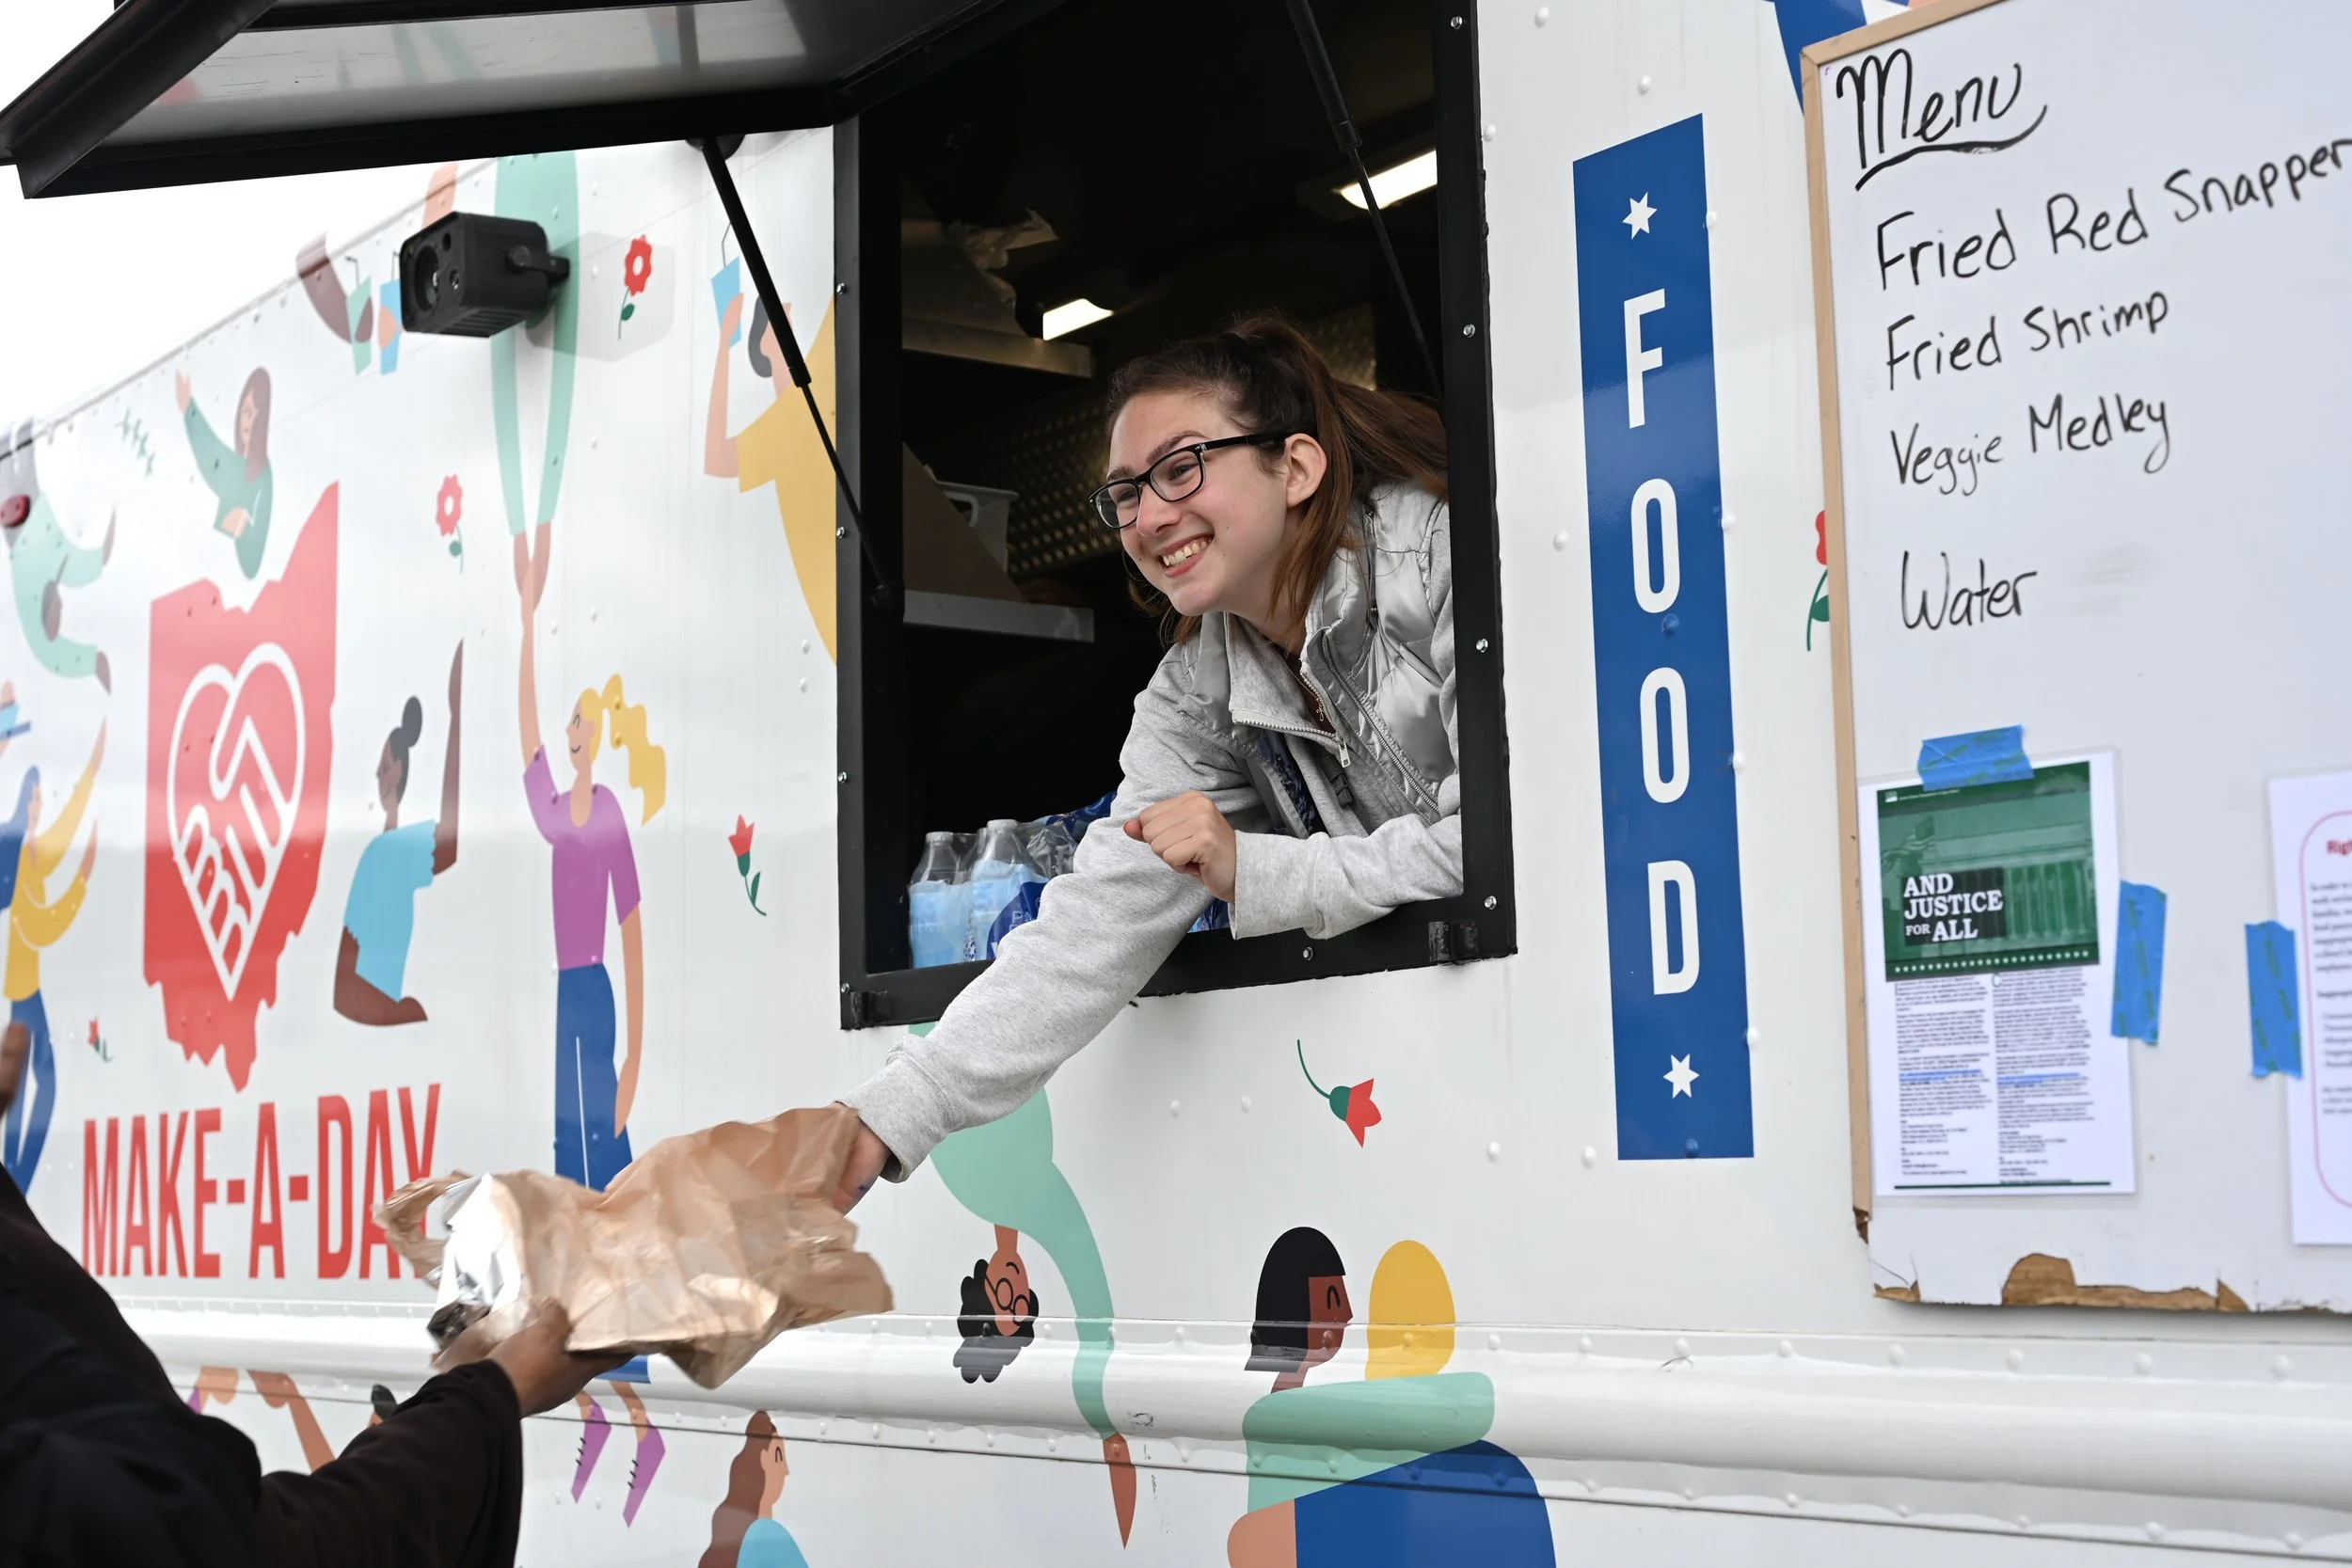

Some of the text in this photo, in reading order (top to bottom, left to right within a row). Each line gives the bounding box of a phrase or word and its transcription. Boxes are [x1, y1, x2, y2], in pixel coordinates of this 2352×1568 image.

[1836, 48, 2022, 170] Menu
[1877, 138, 2352, 291] Fried Red Snapper
[1886, 291, 2169, 391] Fried Shrimp
[1890, 393, 2170, 498] Veggie Medley
[1900, 550, 2038, 631] Water
[1624, 288, 1700, 996] FOOD
[1903, 873, 1954, 897] AND
[1904, 889, 2004, 920] JUSTICE
[1905, 918, 1979, 942] FOR ALL
[82, 1083, 441, 1280] MAKE-A-DAY
